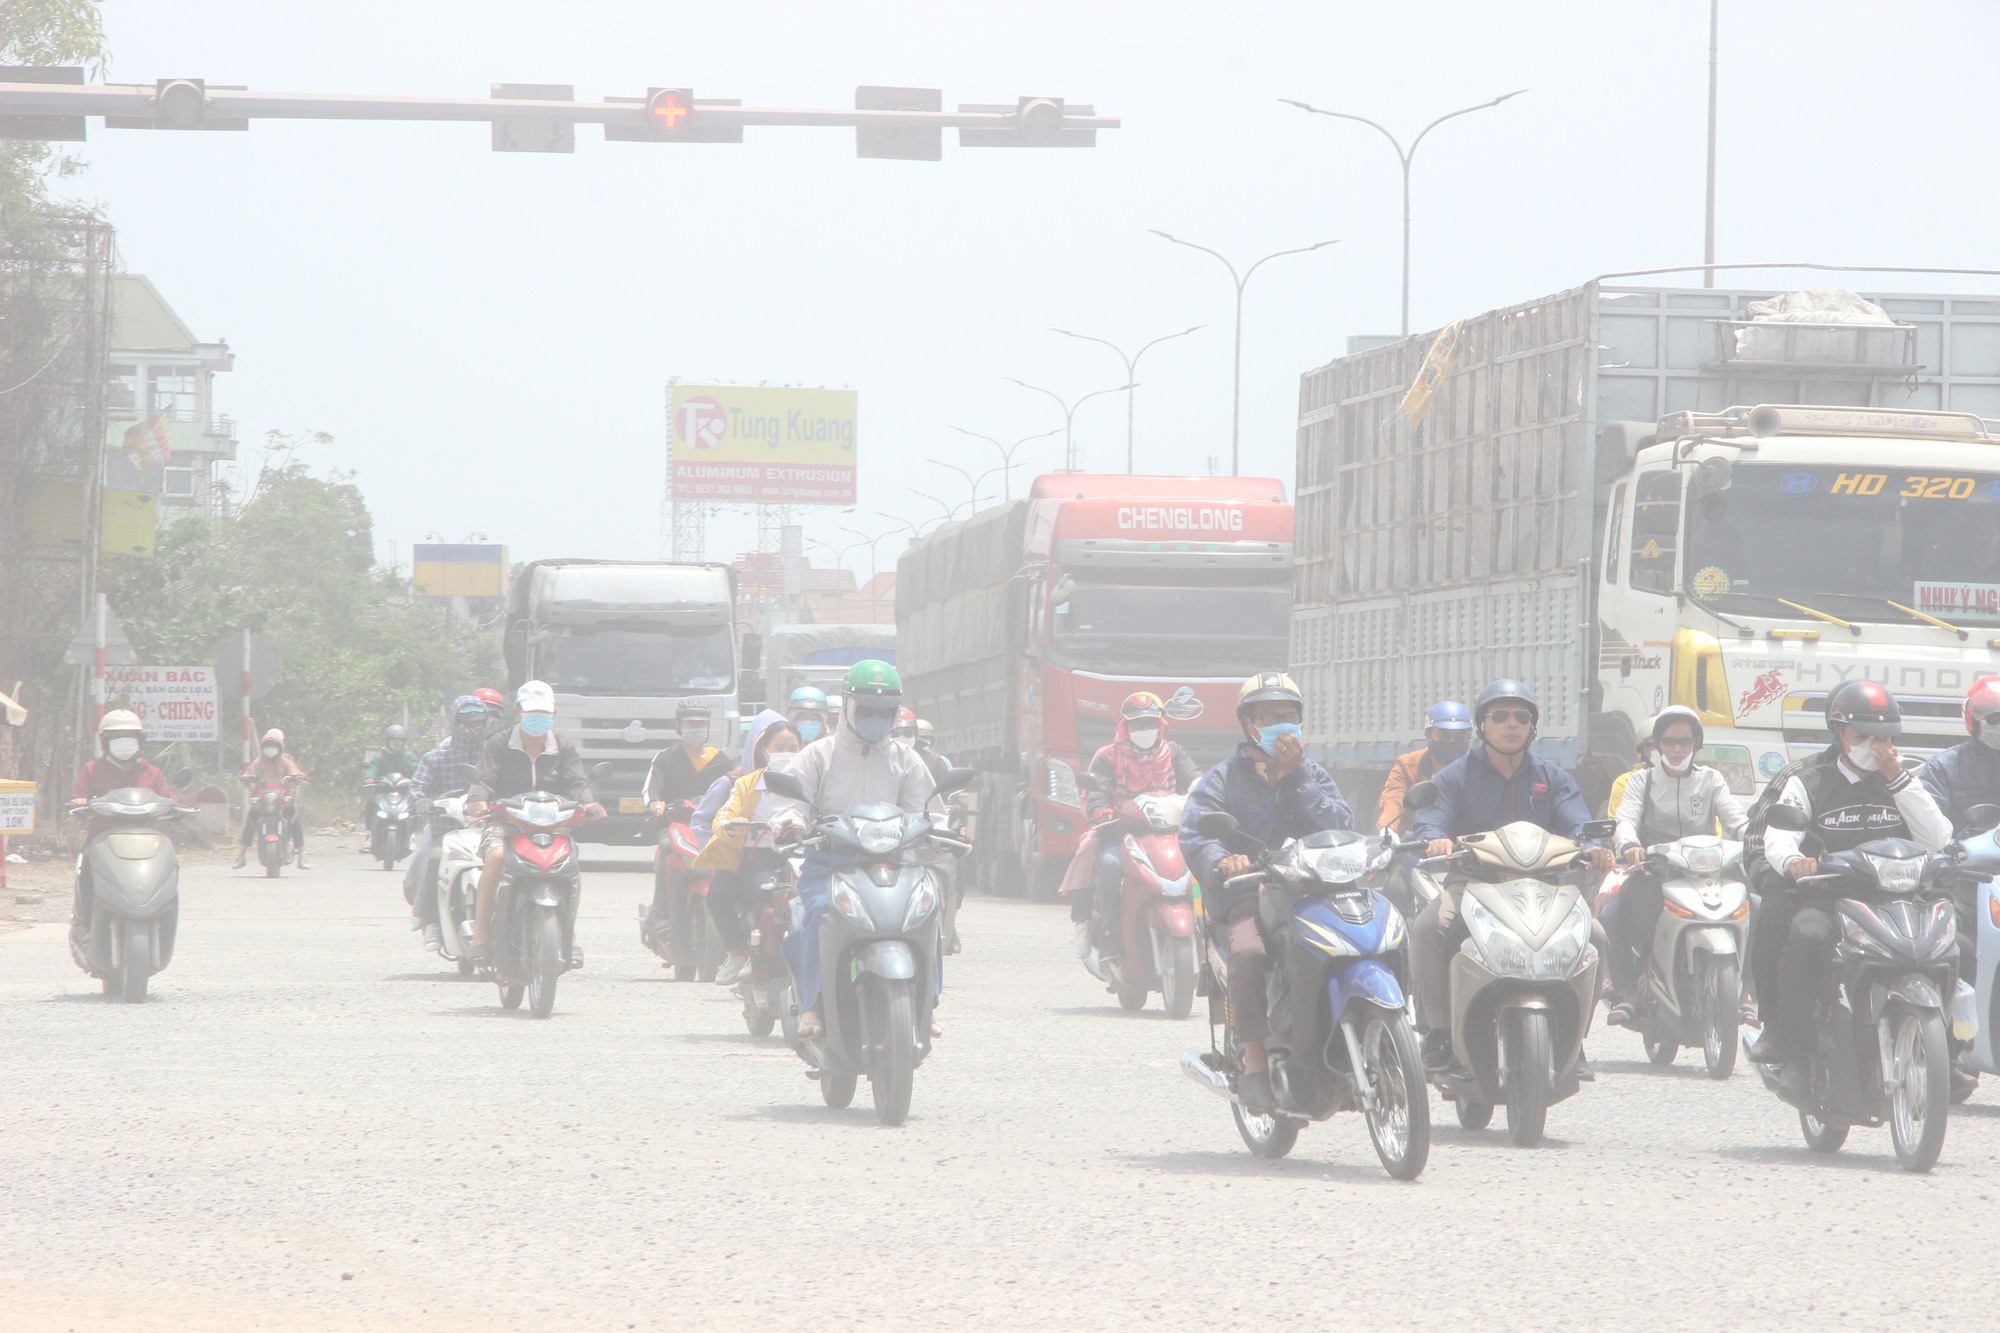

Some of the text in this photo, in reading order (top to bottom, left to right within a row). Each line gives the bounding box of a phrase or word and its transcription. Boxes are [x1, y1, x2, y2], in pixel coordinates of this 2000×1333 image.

[728, 406, 853, 451] Tung Kuang
[676, 465, 851, 483] ALUMINUM EXTRUSION
[1830, 473, 1976, 499] HD 320
[1118, 507, 1243, 531] CHENGLONG
[166, 668, 206, 682] BẮC
[6, 816, 25, 828] 10K
[1824, 810, 1861, 827] BLACK
